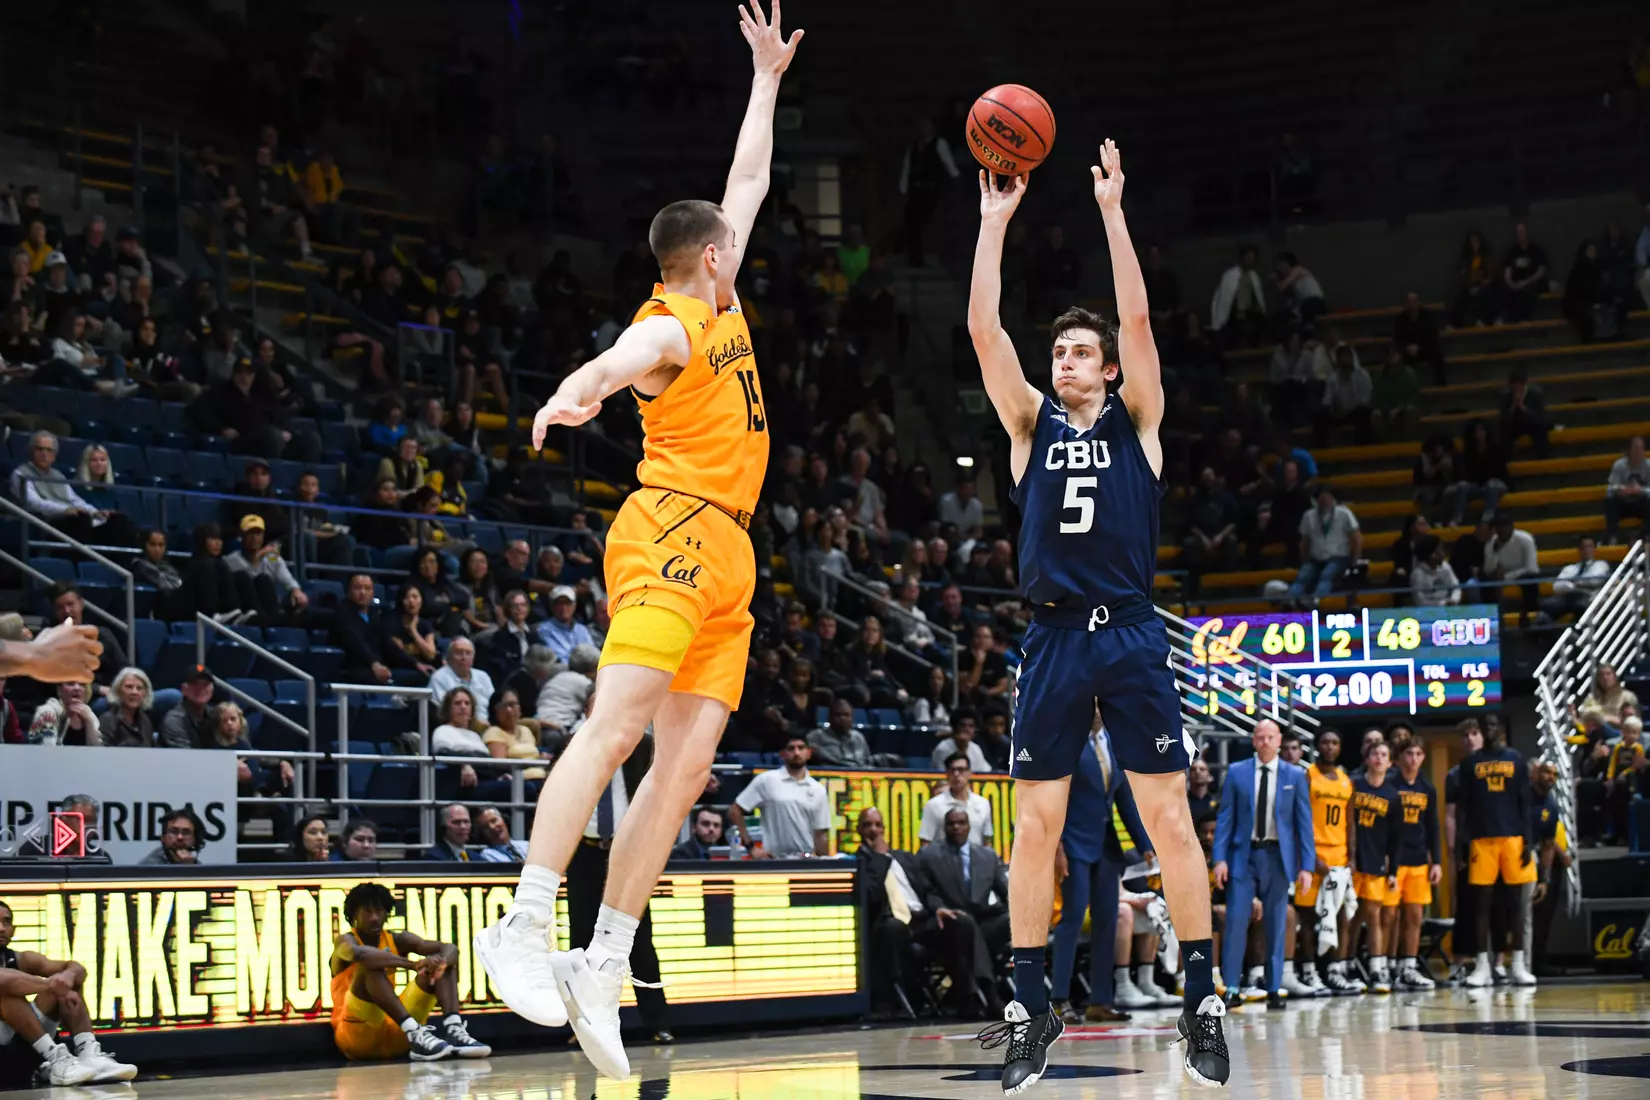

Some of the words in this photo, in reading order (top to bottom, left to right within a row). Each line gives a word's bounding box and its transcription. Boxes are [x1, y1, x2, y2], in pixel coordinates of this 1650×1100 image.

[986, 113, 1027, 149] NCAA
[970, 127, 1017, 171] Wilson
[736, 370, 765, 432] 15
[1044, 439, 1112, 471] CBU
[1059, 476, 1098, 534] 5
[661, 554, 702, 588] Cal
[1261, 622, 1306, 655] 60
[1325, 613, 1357, 630] PER
[1376, 617, 1422, 651] 48
[1431, 618, 1491, 646] CBU
[1191, 617, 1249, 665] Cal
[1331, 629, 1352, 658] 2
[1421, 664, 1450, 680] TOL
[1461, 662, 1490, 679] FLS
[1295, 671, 1393, 707] 12:00
[1427, 681, 1446, 708] 3
[1466, 679, 1486, 707] 2
[0, 800, 34, 841] P
[1326, 804, 1341, 826] 10
[46, 891, 209, 1021] MAKE
[235, 888, 350, 1014] MOR
[1595, 924, 1636, 959] Cal
